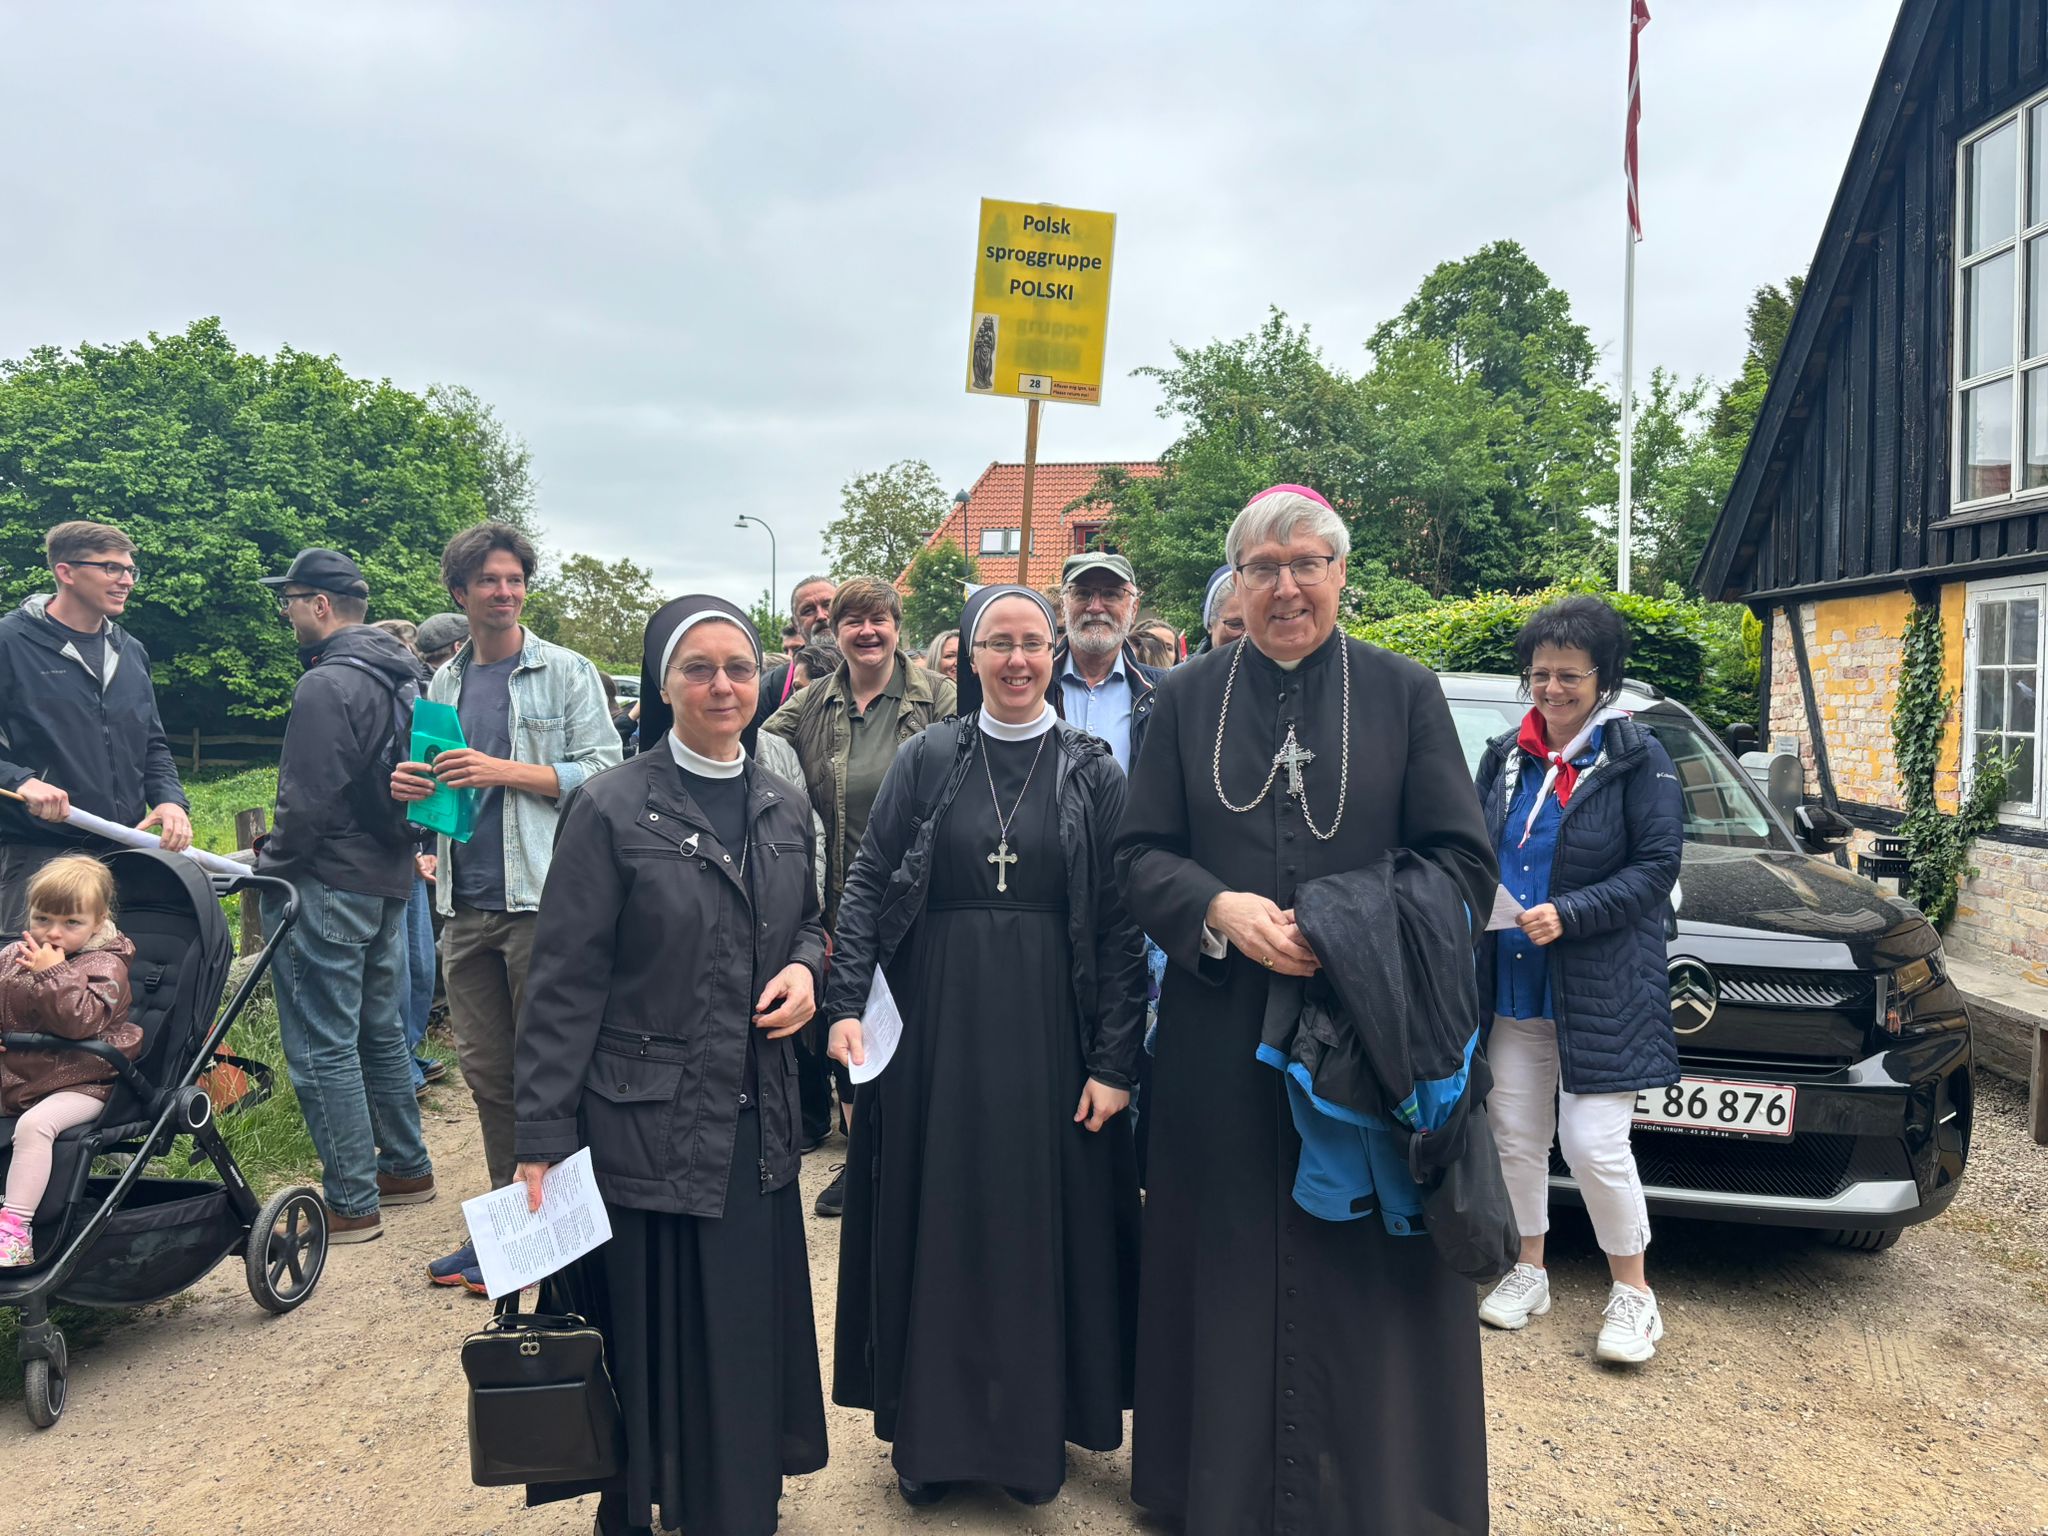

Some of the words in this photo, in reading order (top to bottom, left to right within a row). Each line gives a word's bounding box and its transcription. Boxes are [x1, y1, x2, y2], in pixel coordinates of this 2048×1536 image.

[1023, 214, 1071, 236] Polsk
[986, 245, 1102, 272] sproggruppe
[1009, 278, 1074, 301] POLSKI
[1029, 379, 1041, 389] 28
[1662, 1085, 1708, 1119] 86
[1717, 1090, 1787, 1126] 876
